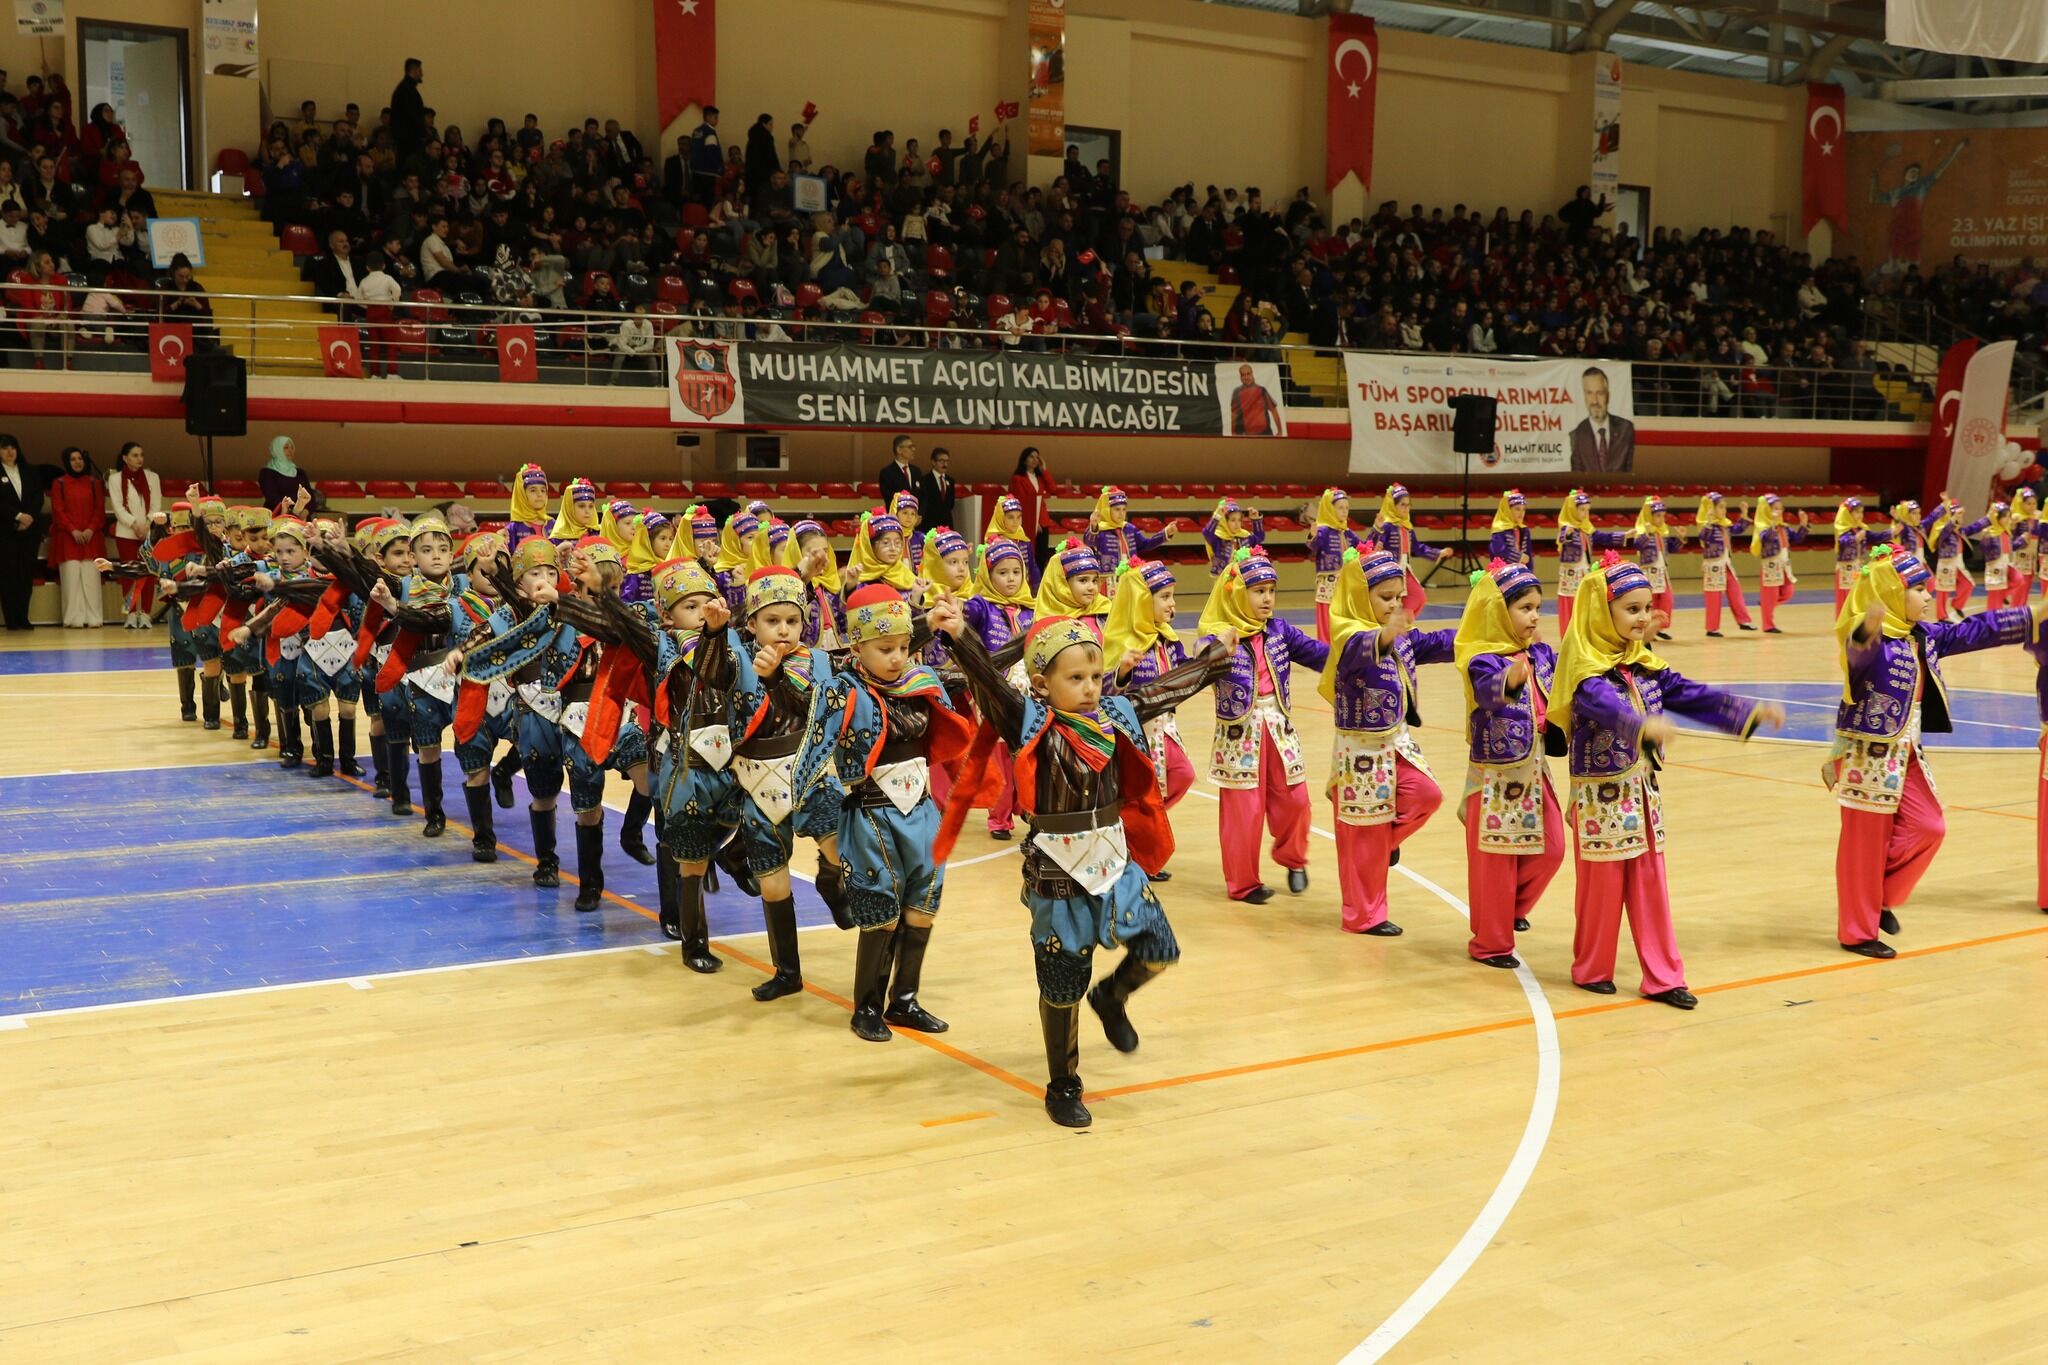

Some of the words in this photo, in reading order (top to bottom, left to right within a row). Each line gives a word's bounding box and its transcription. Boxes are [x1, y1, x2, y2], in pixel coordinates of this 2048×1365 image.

[1952, 217, 1979, 232] 23.
[1984, 216, 2017, 232] YAZ
[2022, 214, 2048, 234] İŞİ
[1950, 233, 2026, 247] OLİMPİYAT
[2028, 234, 2048, 246] OY
[749, 352, 924, 385] MUHAMMET
[932, 359, 1005, 390] AÇICI
[1012, 360, 1209, 396] KALBİMİZDESİN
[1358, 380, 1399, 403] TÜM
[797, 389, 867, 423] SENİ
[875, 396, 951, 425] ASLA
[956, 398, 1181, 431] UNUTMAYACAĞIZ
[1375, 412, 1454, 436] BAŞARIL
[1504, 441, 1537, 454] HAMİT
[1538, 443, 1562, 456] KILIÇ
